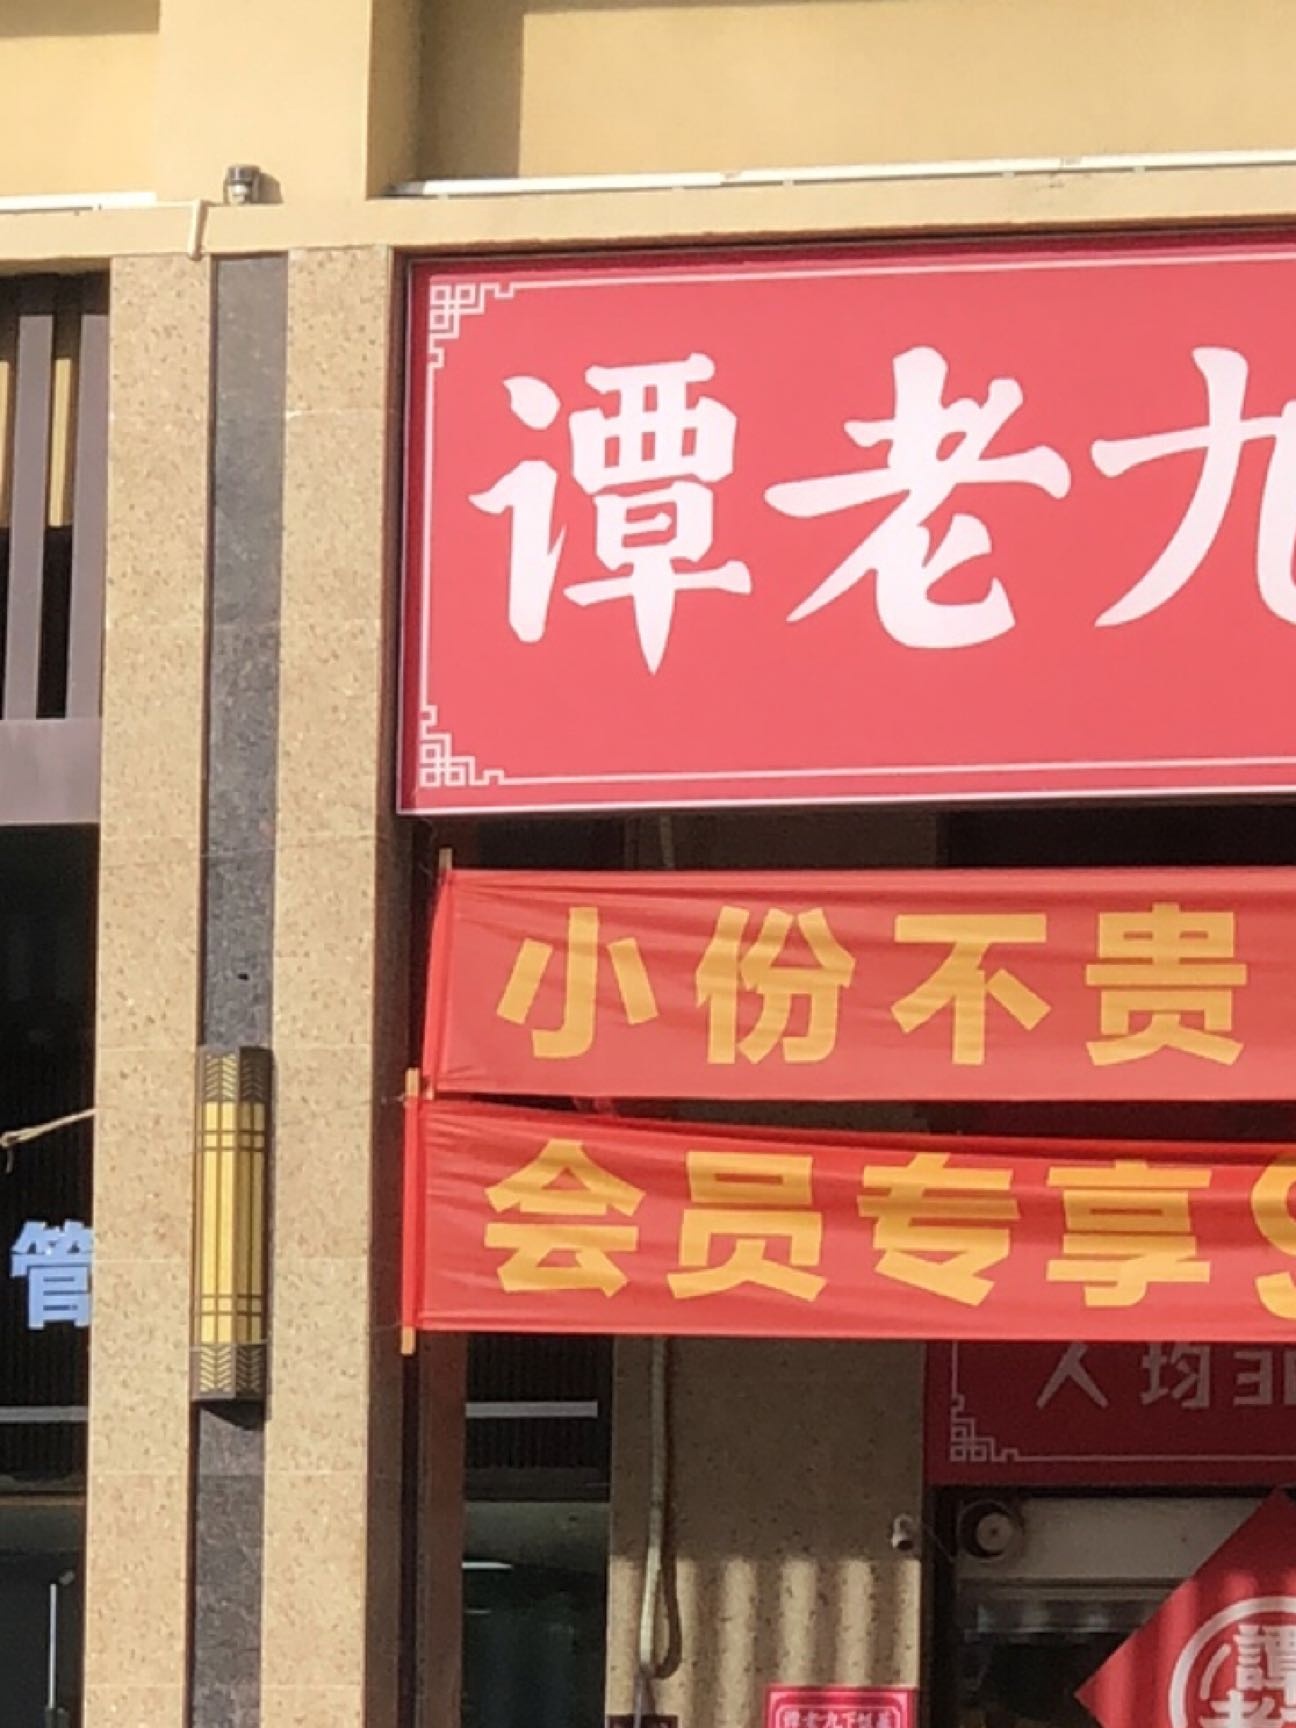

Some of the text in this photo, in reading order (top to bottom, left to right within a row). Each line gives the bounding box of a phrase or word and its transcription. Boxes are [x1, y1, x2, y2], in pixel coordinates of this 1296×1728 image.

[496, 902, 1248, 1066] 小份不贵
[9, 1217, 93, 1330] 管
